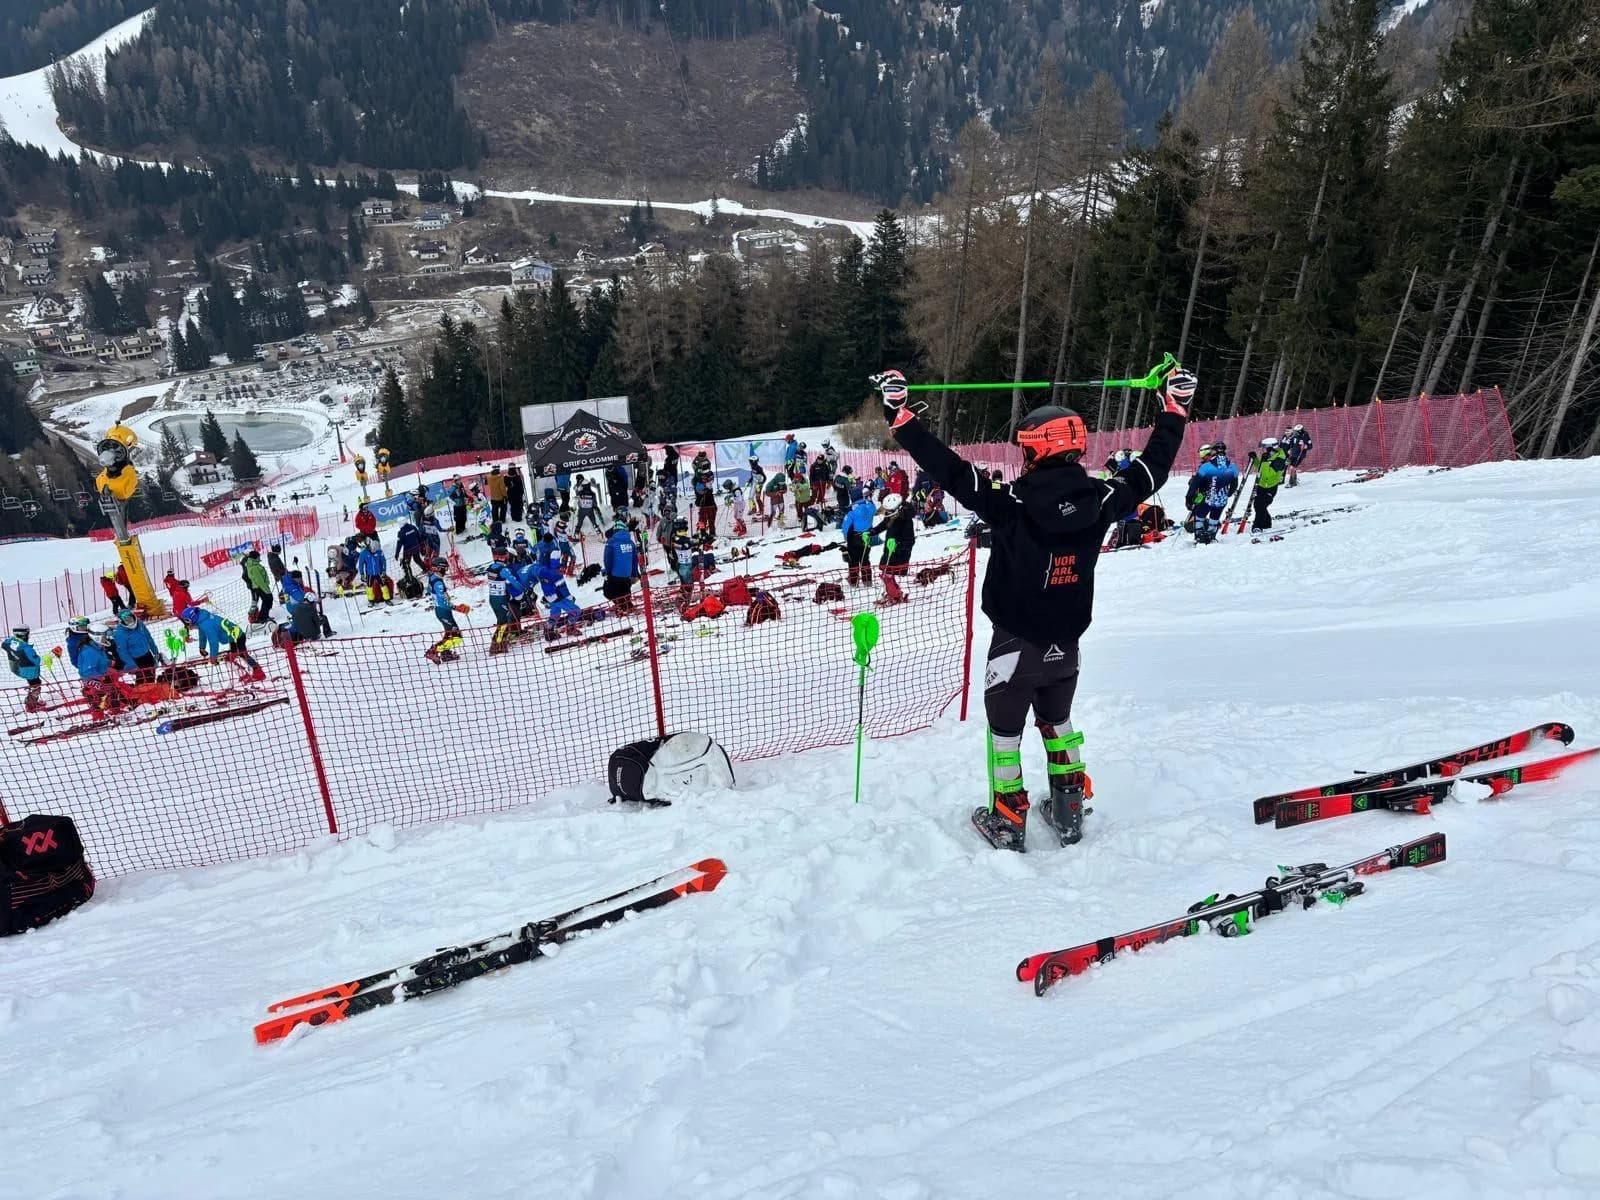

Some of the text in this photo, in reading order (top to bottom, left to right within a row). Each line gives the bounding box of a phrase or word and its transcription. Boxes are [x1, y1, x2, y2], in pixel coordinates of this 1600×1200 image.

[562, 459, 588, 468] GRIFO
[589, 455, 619, 464] GOMME
[1054, 555, 1076, 567] VOR
[1052, 566, 1073, 576] ARL
[1050, 574, 1079, 585] BERG
